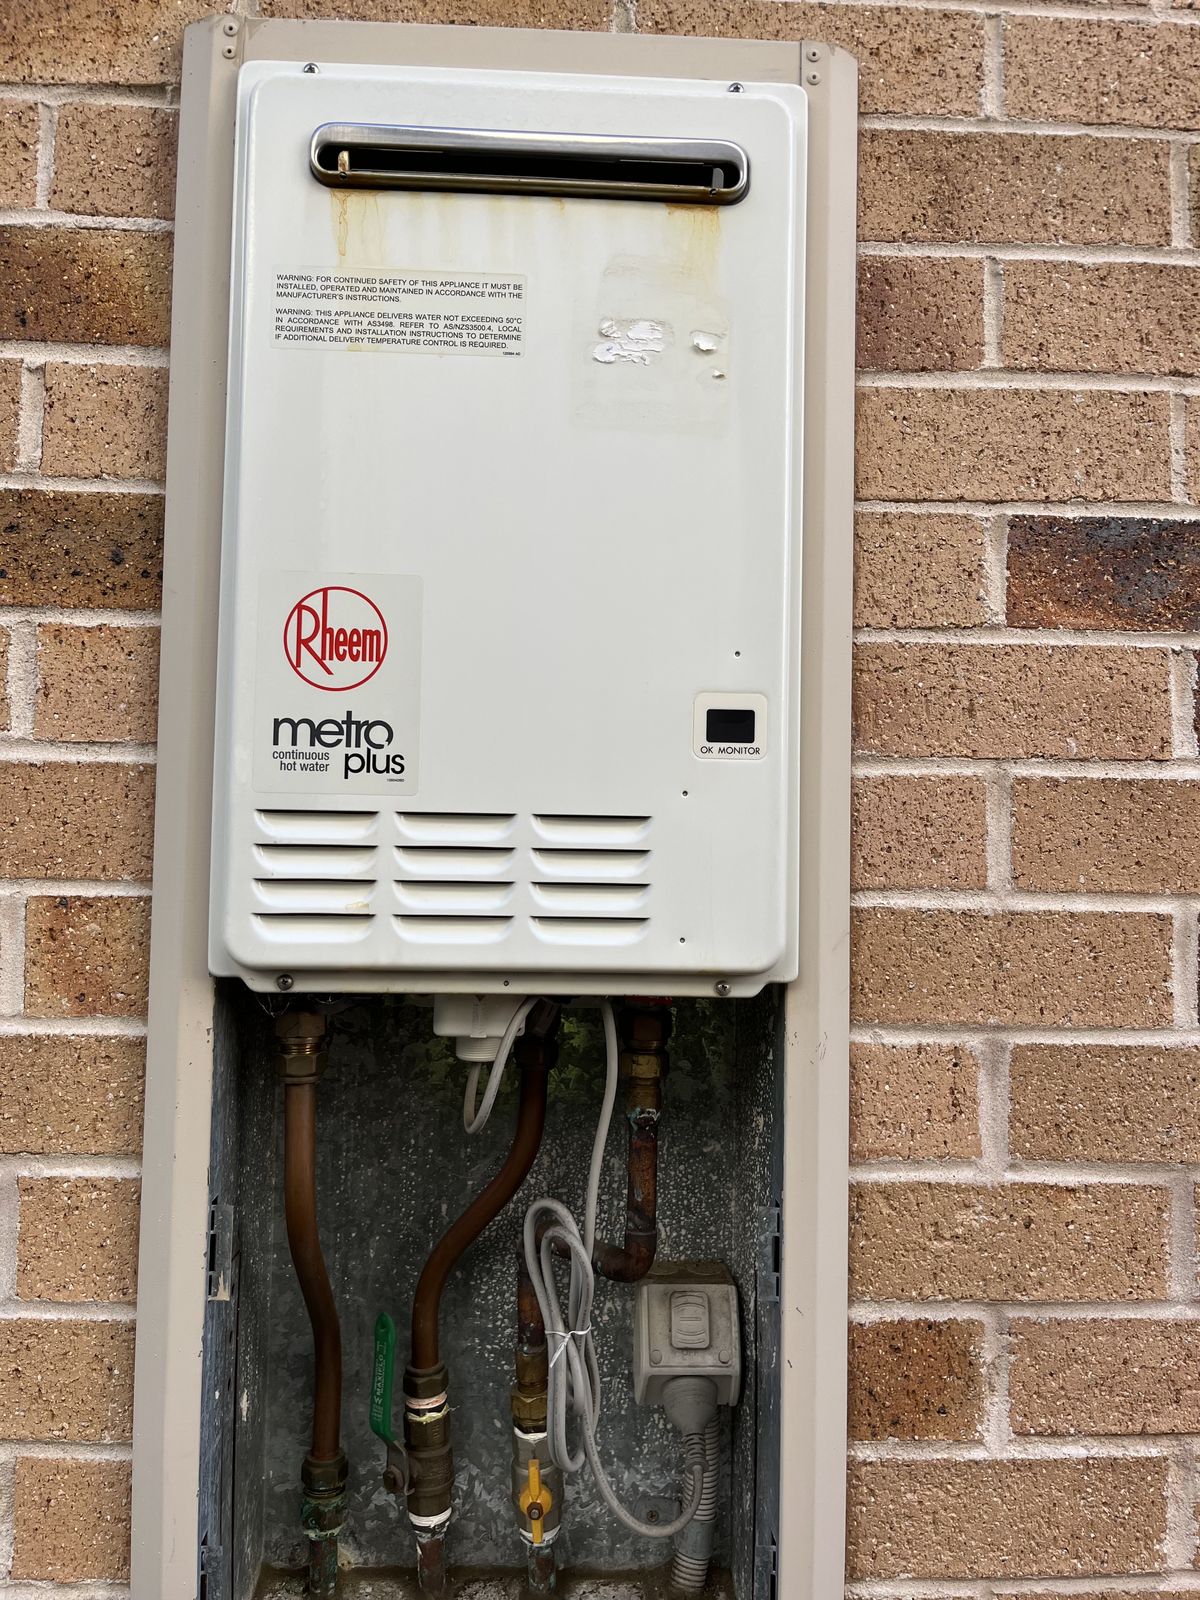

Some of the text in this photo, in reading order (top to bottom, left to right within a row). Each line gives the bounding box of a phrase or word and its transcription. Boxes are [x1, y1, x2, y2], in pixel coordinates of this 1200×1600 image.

[276, 283, 318, 292] INSTALLED,
[434, 289, 486, 297] ACCORDANCE
[276, 291, 401, 302] MANUFACTURER'S INSTRUCTIONS.
[275, 325, 334, 334] REQUIREMENTS
[354, 328, 406, 336] INSTALLATION
[409, 330, 463, 338] INSTRUCTIONS
[367, 337, 421, 345] TEMPERATURE
[296, 588, 381, 675] Rheem
[272, 710, 394, 750] metro
[272, 750, 330, 760] continuous
[700, 746, 760, 755] OK MONITOR
[280, 761, 330, 772] hot water
[344, 748, 405, 779] plus
